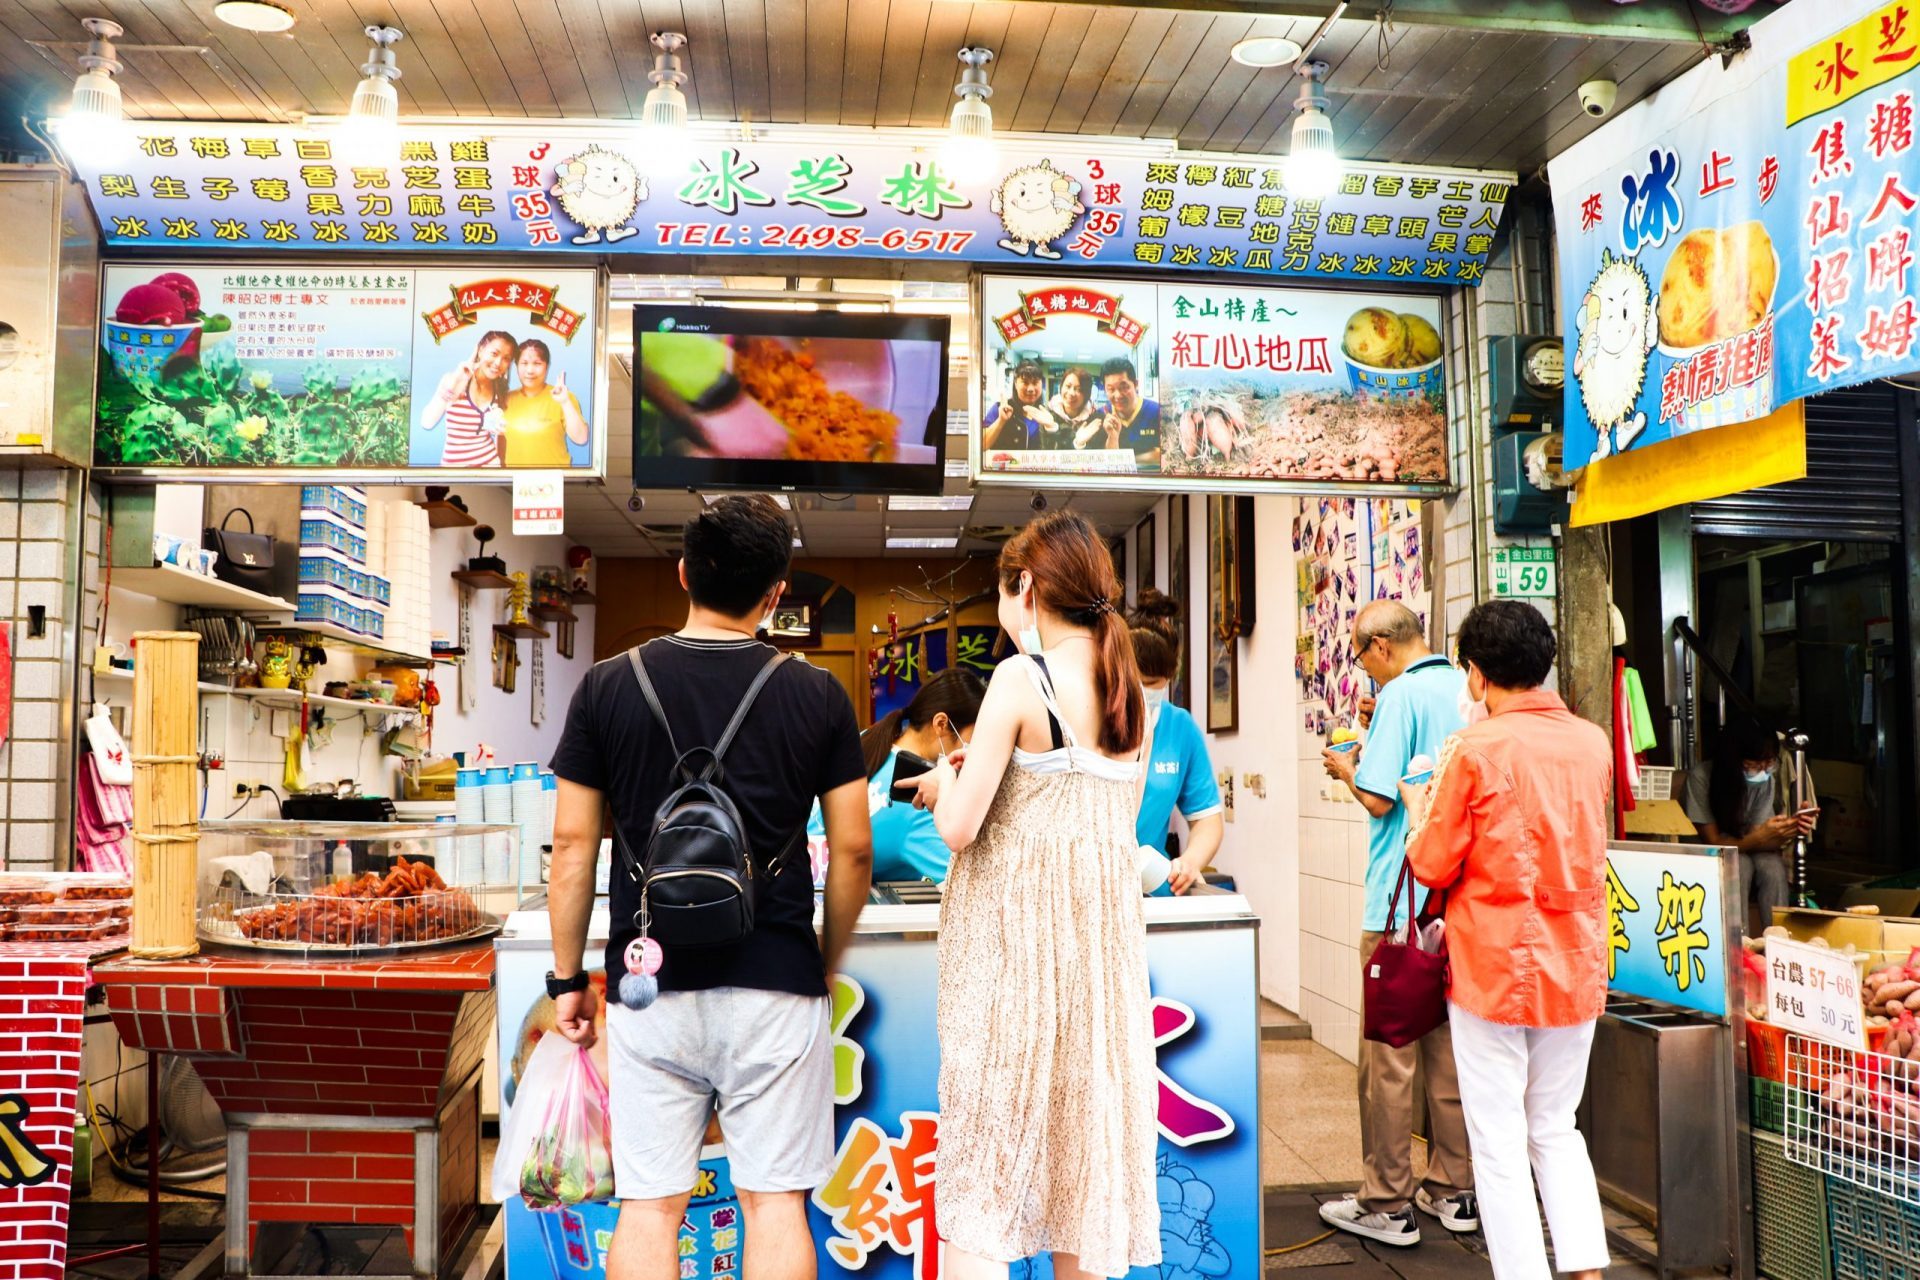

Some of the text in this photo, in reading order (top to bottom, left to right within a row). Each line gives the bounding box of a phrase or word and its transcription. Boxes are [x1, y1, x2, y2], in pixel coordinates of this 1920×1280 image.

[190, 137, 248, 240] 梅子冰
[242, 138, 298, 241] 草莓冰
[400, 140, 448, 243] 黑芝麻冰
[451, 140, 498, 244] 雞蛋牛奶
[677, 148, 972, 218] 冰芝林
[1134, 162, 1179, 263] 萊姆葡萄
[1171, 165, 1216, 265] 檸檬冰
[1208, 167, 1255, 266] 紅豆冰
[1352, 175, 1403, 274] 香草冰
[1388, 177, 1440, 276] 芋頭冰
[1422, 180, 1473, 278] 土芒果冰
[1457, 182, 1510, 280] 仙人掌冰
[461, 283, 545, 308] 仙人掌冰
[1030, 294, 1110, 316] 焦糖地瓜
[1172, 330, 1332, 374] 紅心地瓜
[1660, 314, 1772, 422] 熱情推薦
[1519, 566, 1548, 591] 59
